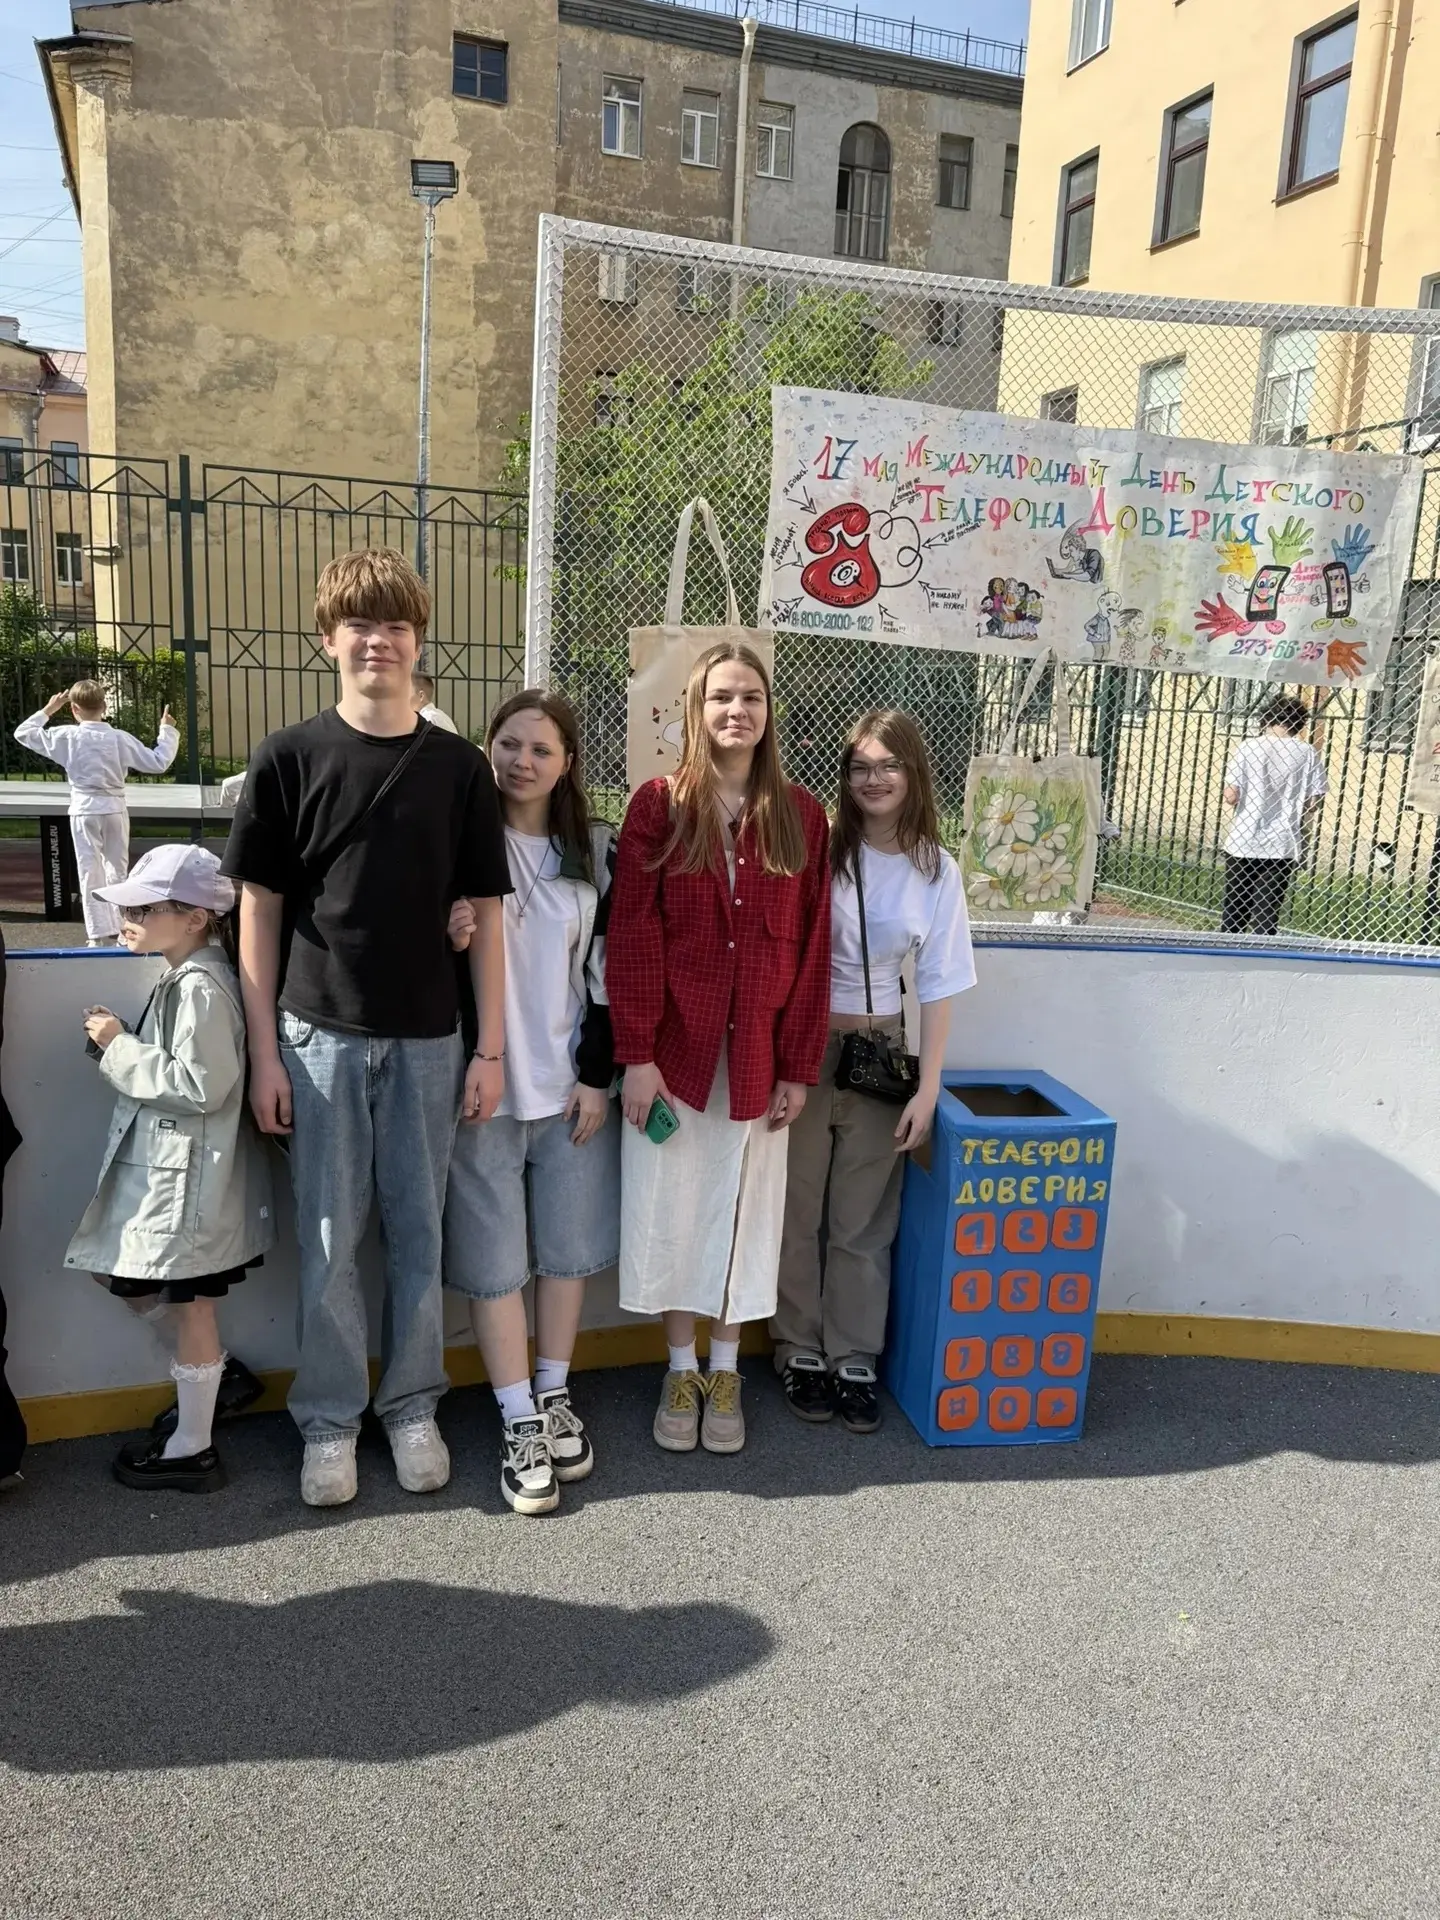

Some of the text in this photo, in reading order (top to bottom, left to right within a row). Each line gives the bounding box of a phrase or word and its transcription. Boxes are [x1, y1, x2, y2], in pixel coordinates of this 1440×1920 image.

[813, 436, 858, 480] 17
[905, 435, 1110, 488] МЕЖДУНАРОДНЫЙ
[1120, 453, 1196, 494] ДЕНЬ
[1204, 464, 1364, 513] ДЕТСКОГО
[915, 485, 1264, 546] ТЕЛЕФОНА ДОВЕРИЯ
[1229, 638, 1327, 660] 273-66-25
[49, 825, 62, 907] WWW.START-LINE.RU
[961, 1137, 1105, 1166] ТЕЛЕФОН
[954, 1175, 1107, 1205] ДОВЕРИЯ
[963, 1213, 1084, 1250] 1 2 3
[962, 1277, 1079, 1305] 4 5 6
[957, 1340, 1073, 1372] 7 8 9
[998, 1396, 1018, 1422] 0
